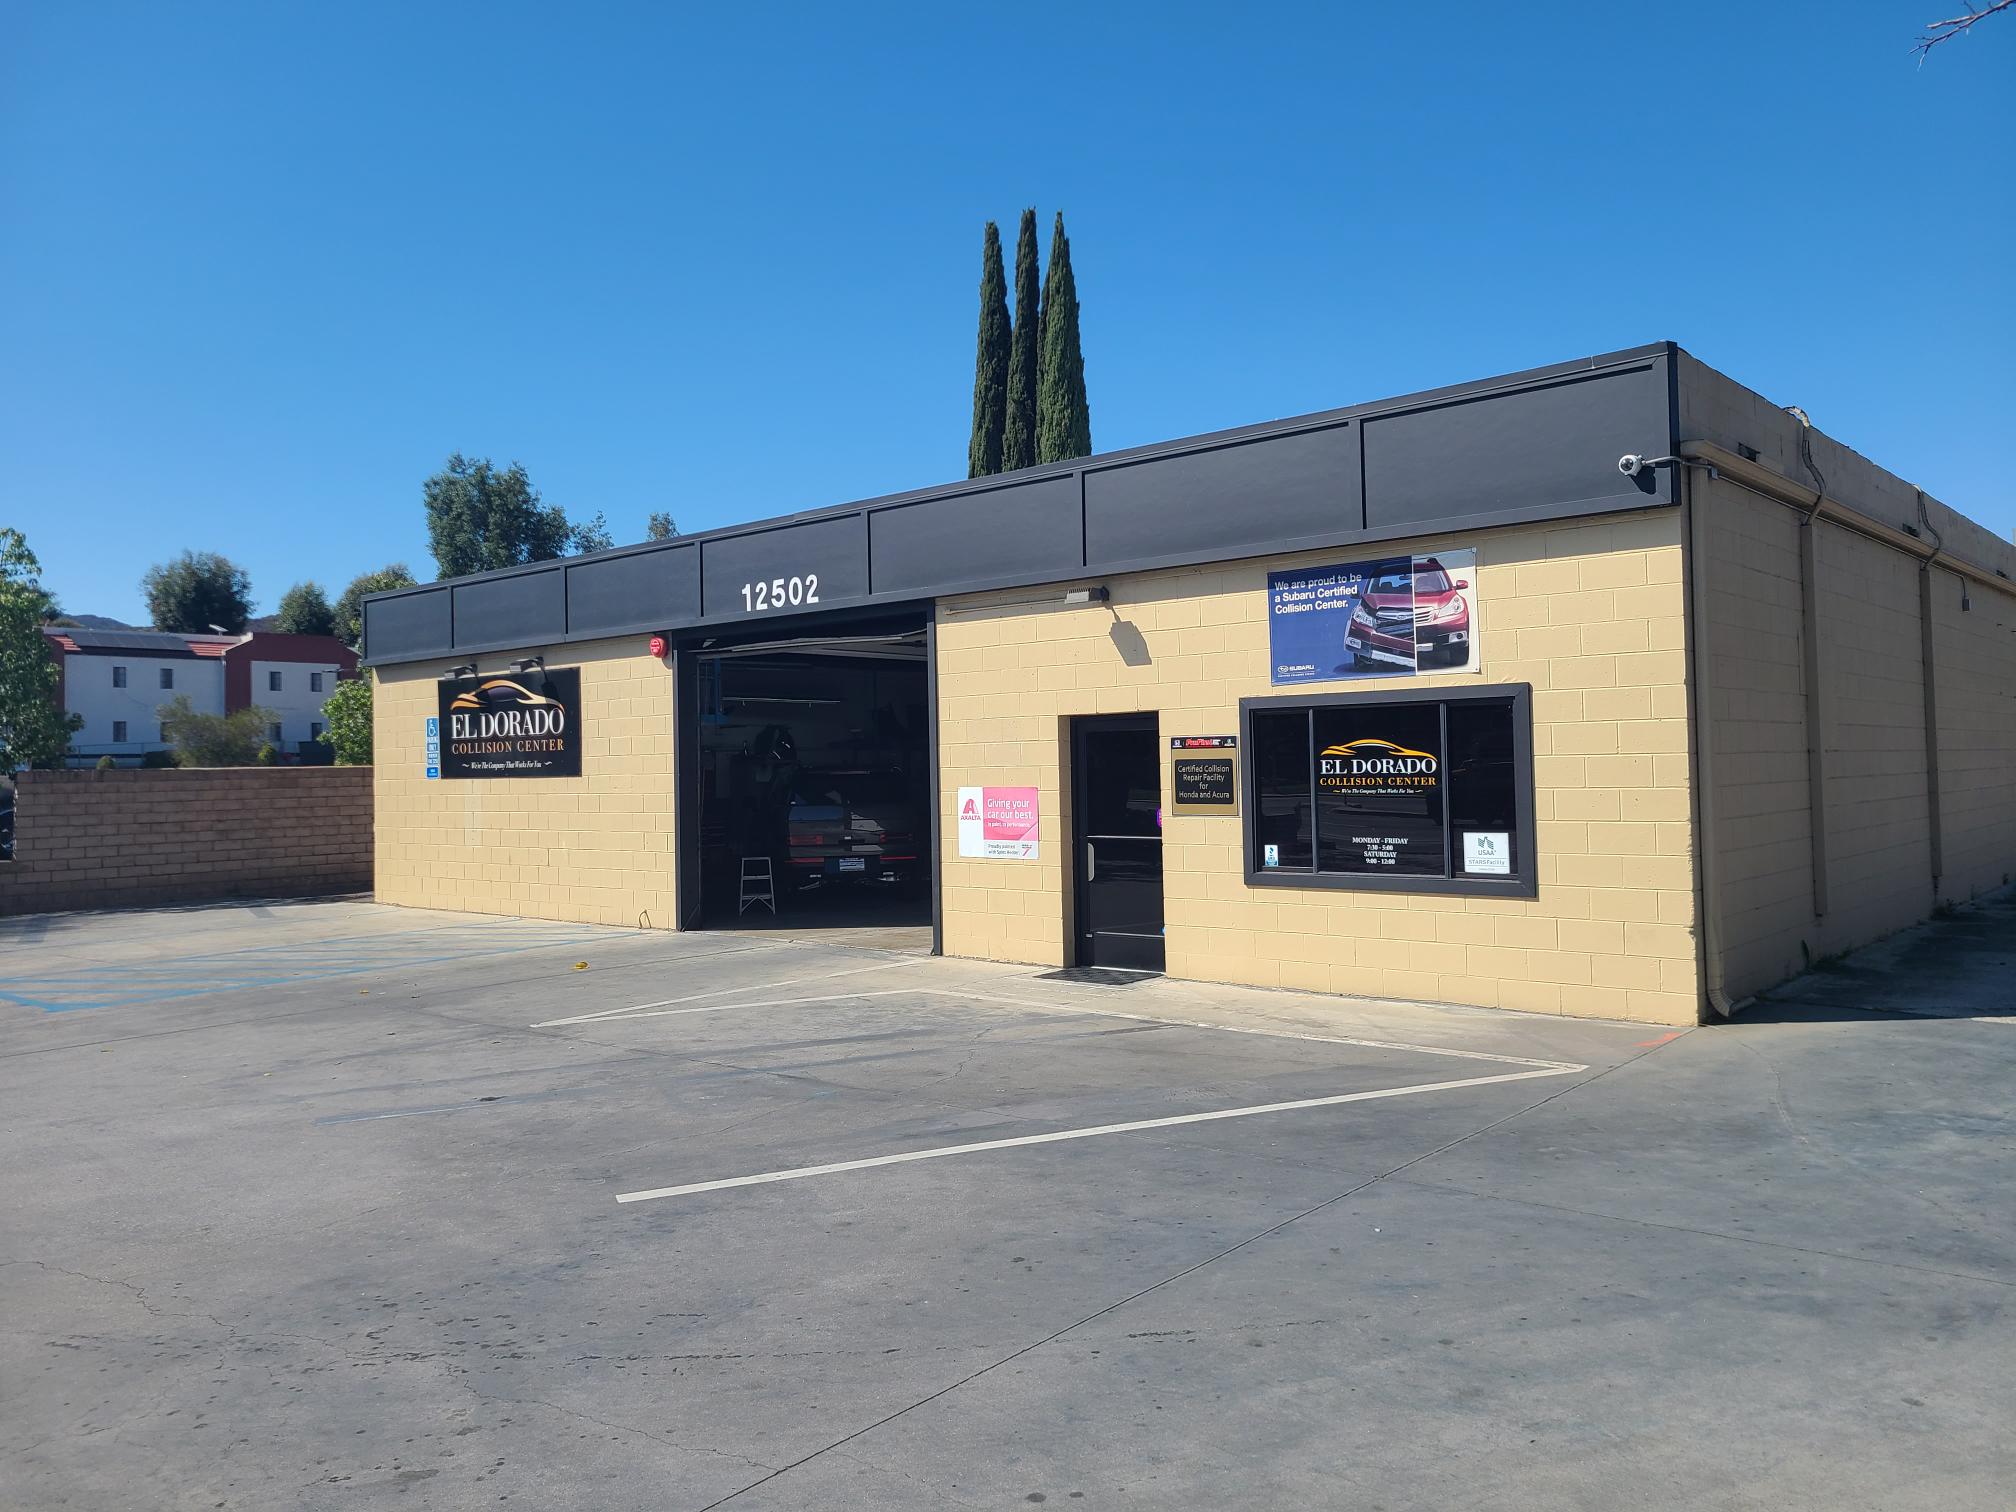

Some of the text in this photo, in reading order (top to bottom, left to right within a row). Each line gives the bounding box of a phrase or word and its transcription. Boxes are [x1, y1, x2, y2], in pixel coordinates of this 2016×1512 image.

[1275, 573, 1362, 590] We are proud to be
[742, 574, 820, 612] 12502
[1282, 591, 1315, 602] Subaru
[1317, 585, 1358, 598] Certified
[1275, 600, 1348, 614] Collision Center.
[451, 708, 564, 739] EL DORADO
[452, 742, 512, 755] COLLISION
[517, 738, 564, 752] CENTER
[1320, 758, 1437, 774] EL DORADO
[1183, 774, 1224, 782] Repair Facility
[1320, 777, 1436, 786] COLLISION CENTER
[988, 799, 1029, 809] Giving your
[1014, 810, 1034, 819] best.
